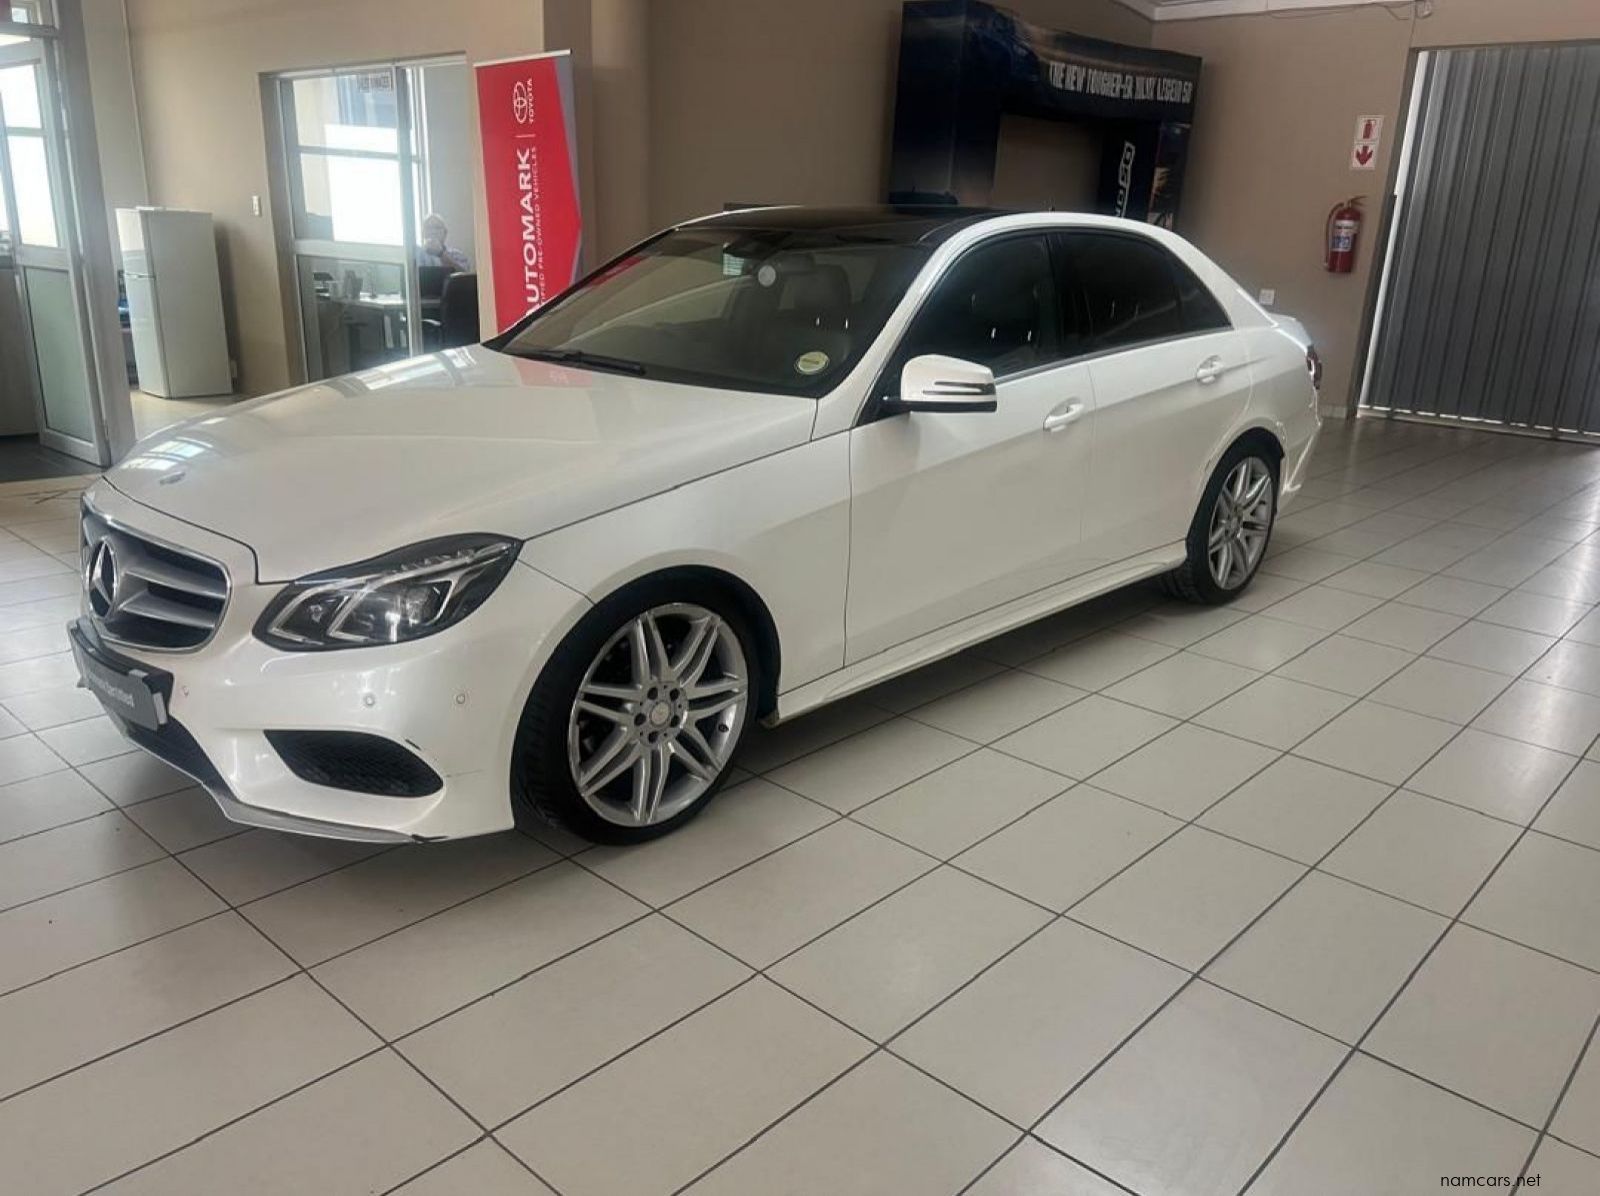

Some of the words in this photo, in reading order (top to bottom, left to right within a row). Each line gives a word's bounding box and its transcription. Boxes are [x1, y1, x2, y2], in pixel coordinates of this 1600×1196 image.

[526, 78, 535, 124] TOYOTA
[531, 146, 540, 201] VEHICLES
[534, 204, 544, 270] PRE-OWNED
